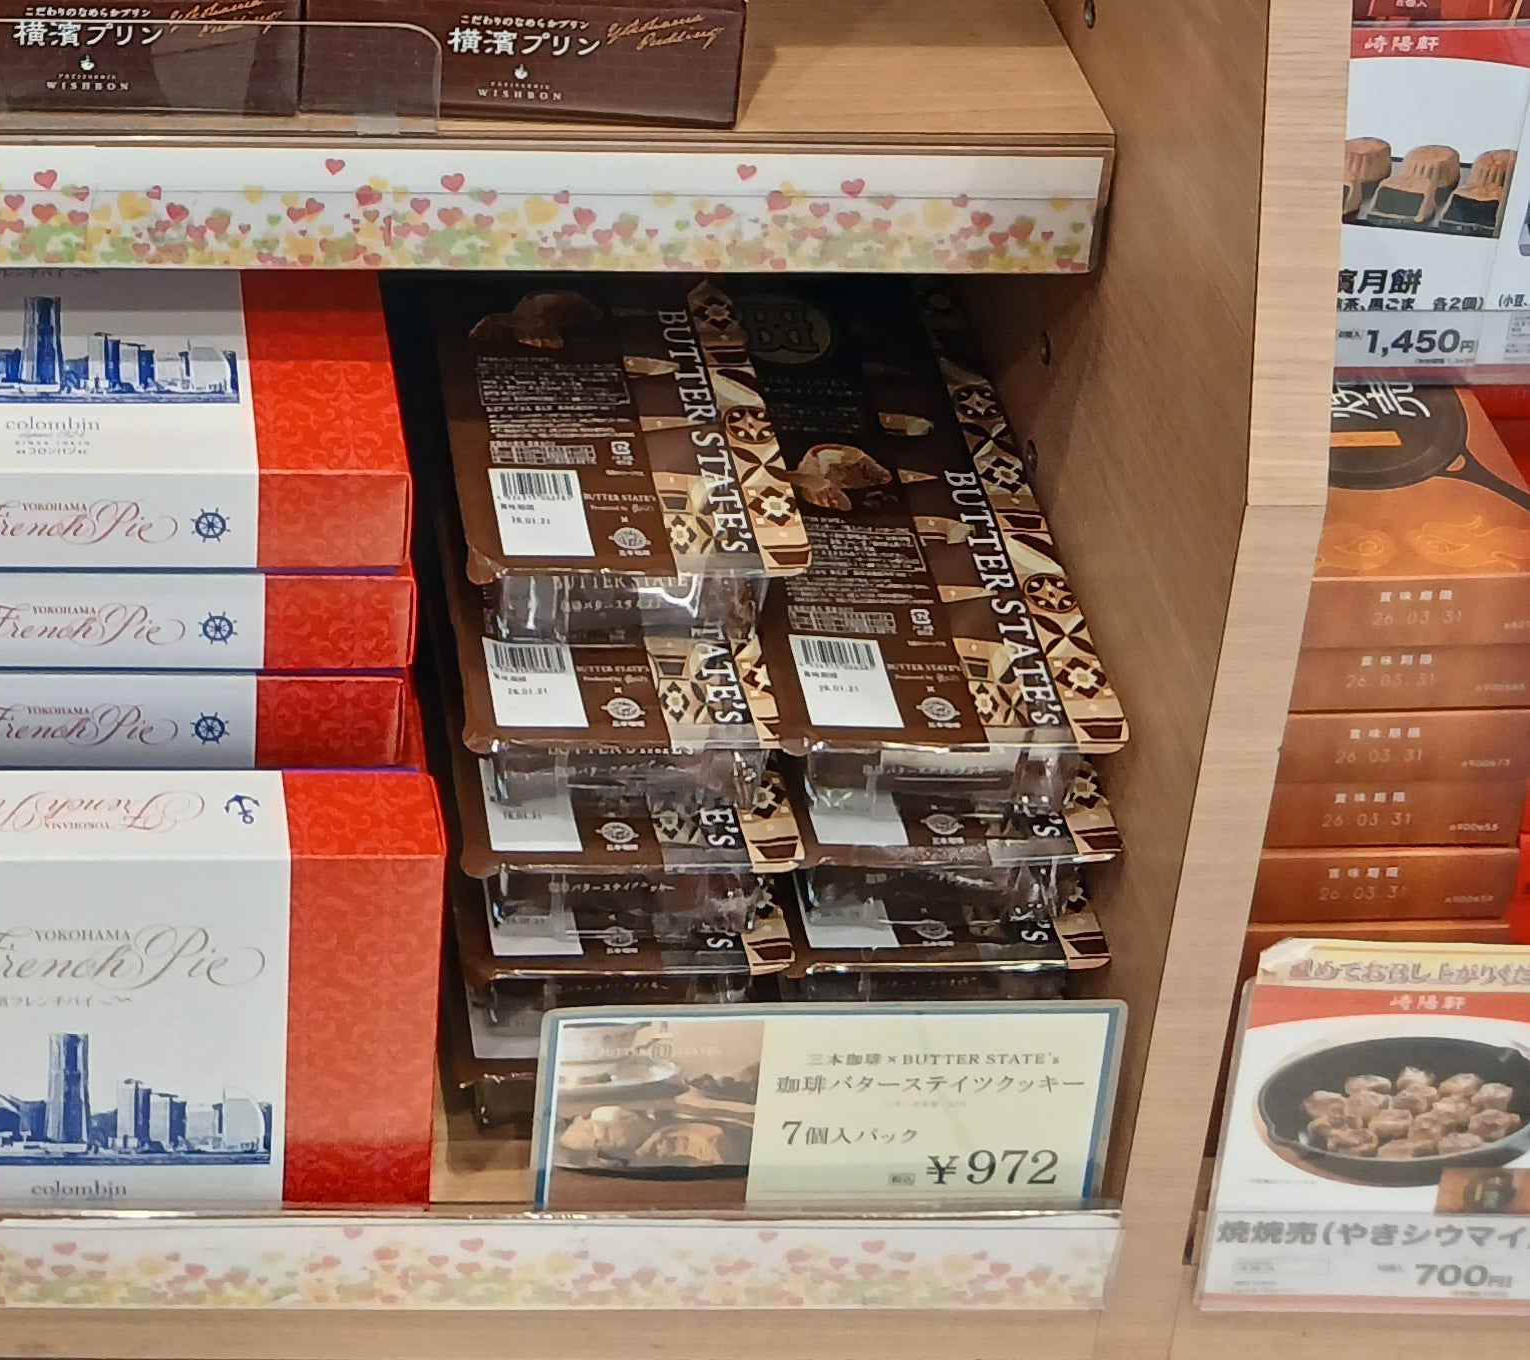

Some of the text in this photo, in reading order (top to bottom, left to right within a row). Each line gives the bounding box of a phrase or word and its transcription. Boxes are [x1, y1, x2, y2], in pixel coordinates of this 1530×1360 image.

[656, 308, 718, 424] BUTTER
[5, 416, 101, 431] colombin
[21, 502, 88, 512] YOKOHAMA
[944, 469, 1016, 591] BUTTER
[34, 928, 132, 942] YOKOHAMA
[902, 1054, 980, 1066] BUTTER
[776, 1074, 1085, 1097] 珈琲バターステイツクッキー
[780, 1119, 920, 1146] 7個入パック
[925, 1148, 1058, 1185] ¥972
[30, 1180, 127, 1198] colombin
